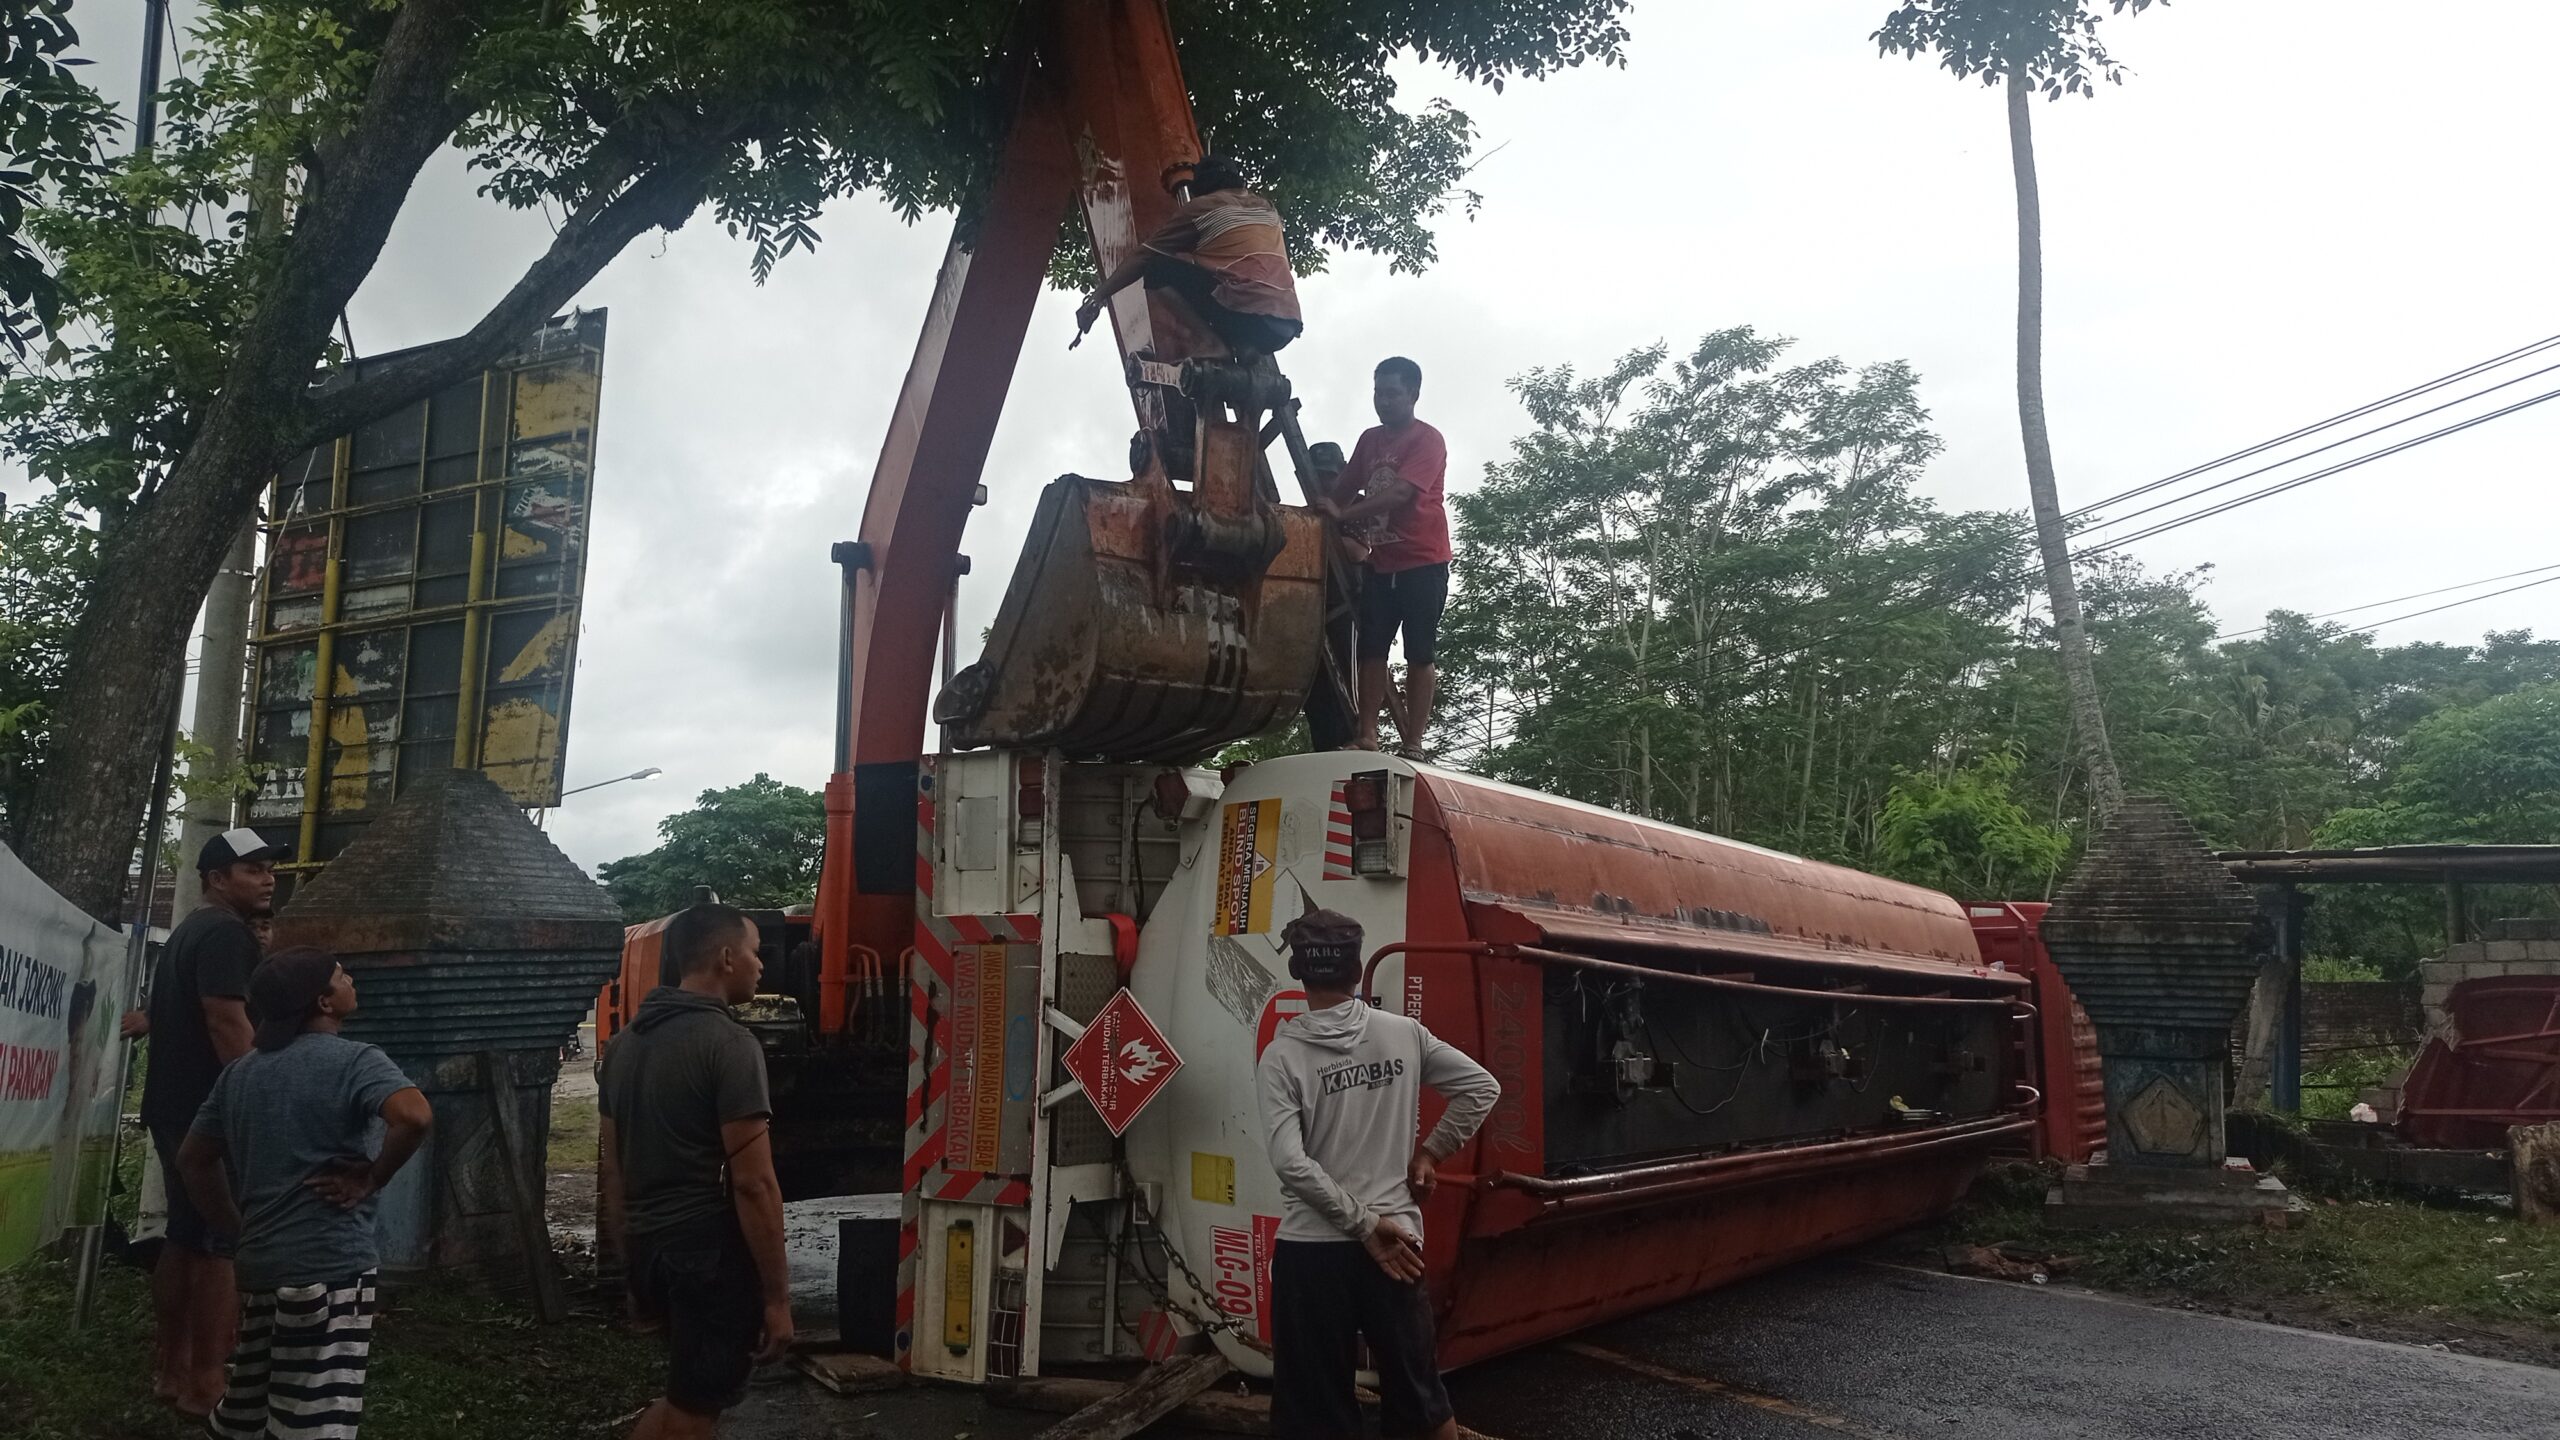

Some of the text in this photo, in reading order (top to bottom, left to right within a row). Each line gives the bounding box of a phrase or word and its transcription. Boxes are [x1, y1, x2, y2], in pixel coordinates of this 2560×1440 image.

[1215, 814, 1230, 926] TERLIHAT SOPIR
[1223, 828, 1235, 909] ANDA TIDAK
[1230, 808, 1247, 928] BLIND SPOT
[1239, 807, 1257, 928] SEGERA MENJAUH
[957, 952, 976, 999] AWAS
[1408, 976, 1423, 991] PT
[975, 950, 1003, 1167] AWAS KENDARAAN PANJANG DAN LEBAR
[1100, 1015, 1111, 1107] MUDAH TERBAKAR
[1322, 1058, 1404, 1096] KAYABAS
[1213, 1228, 1254, 1316] MLG-09
